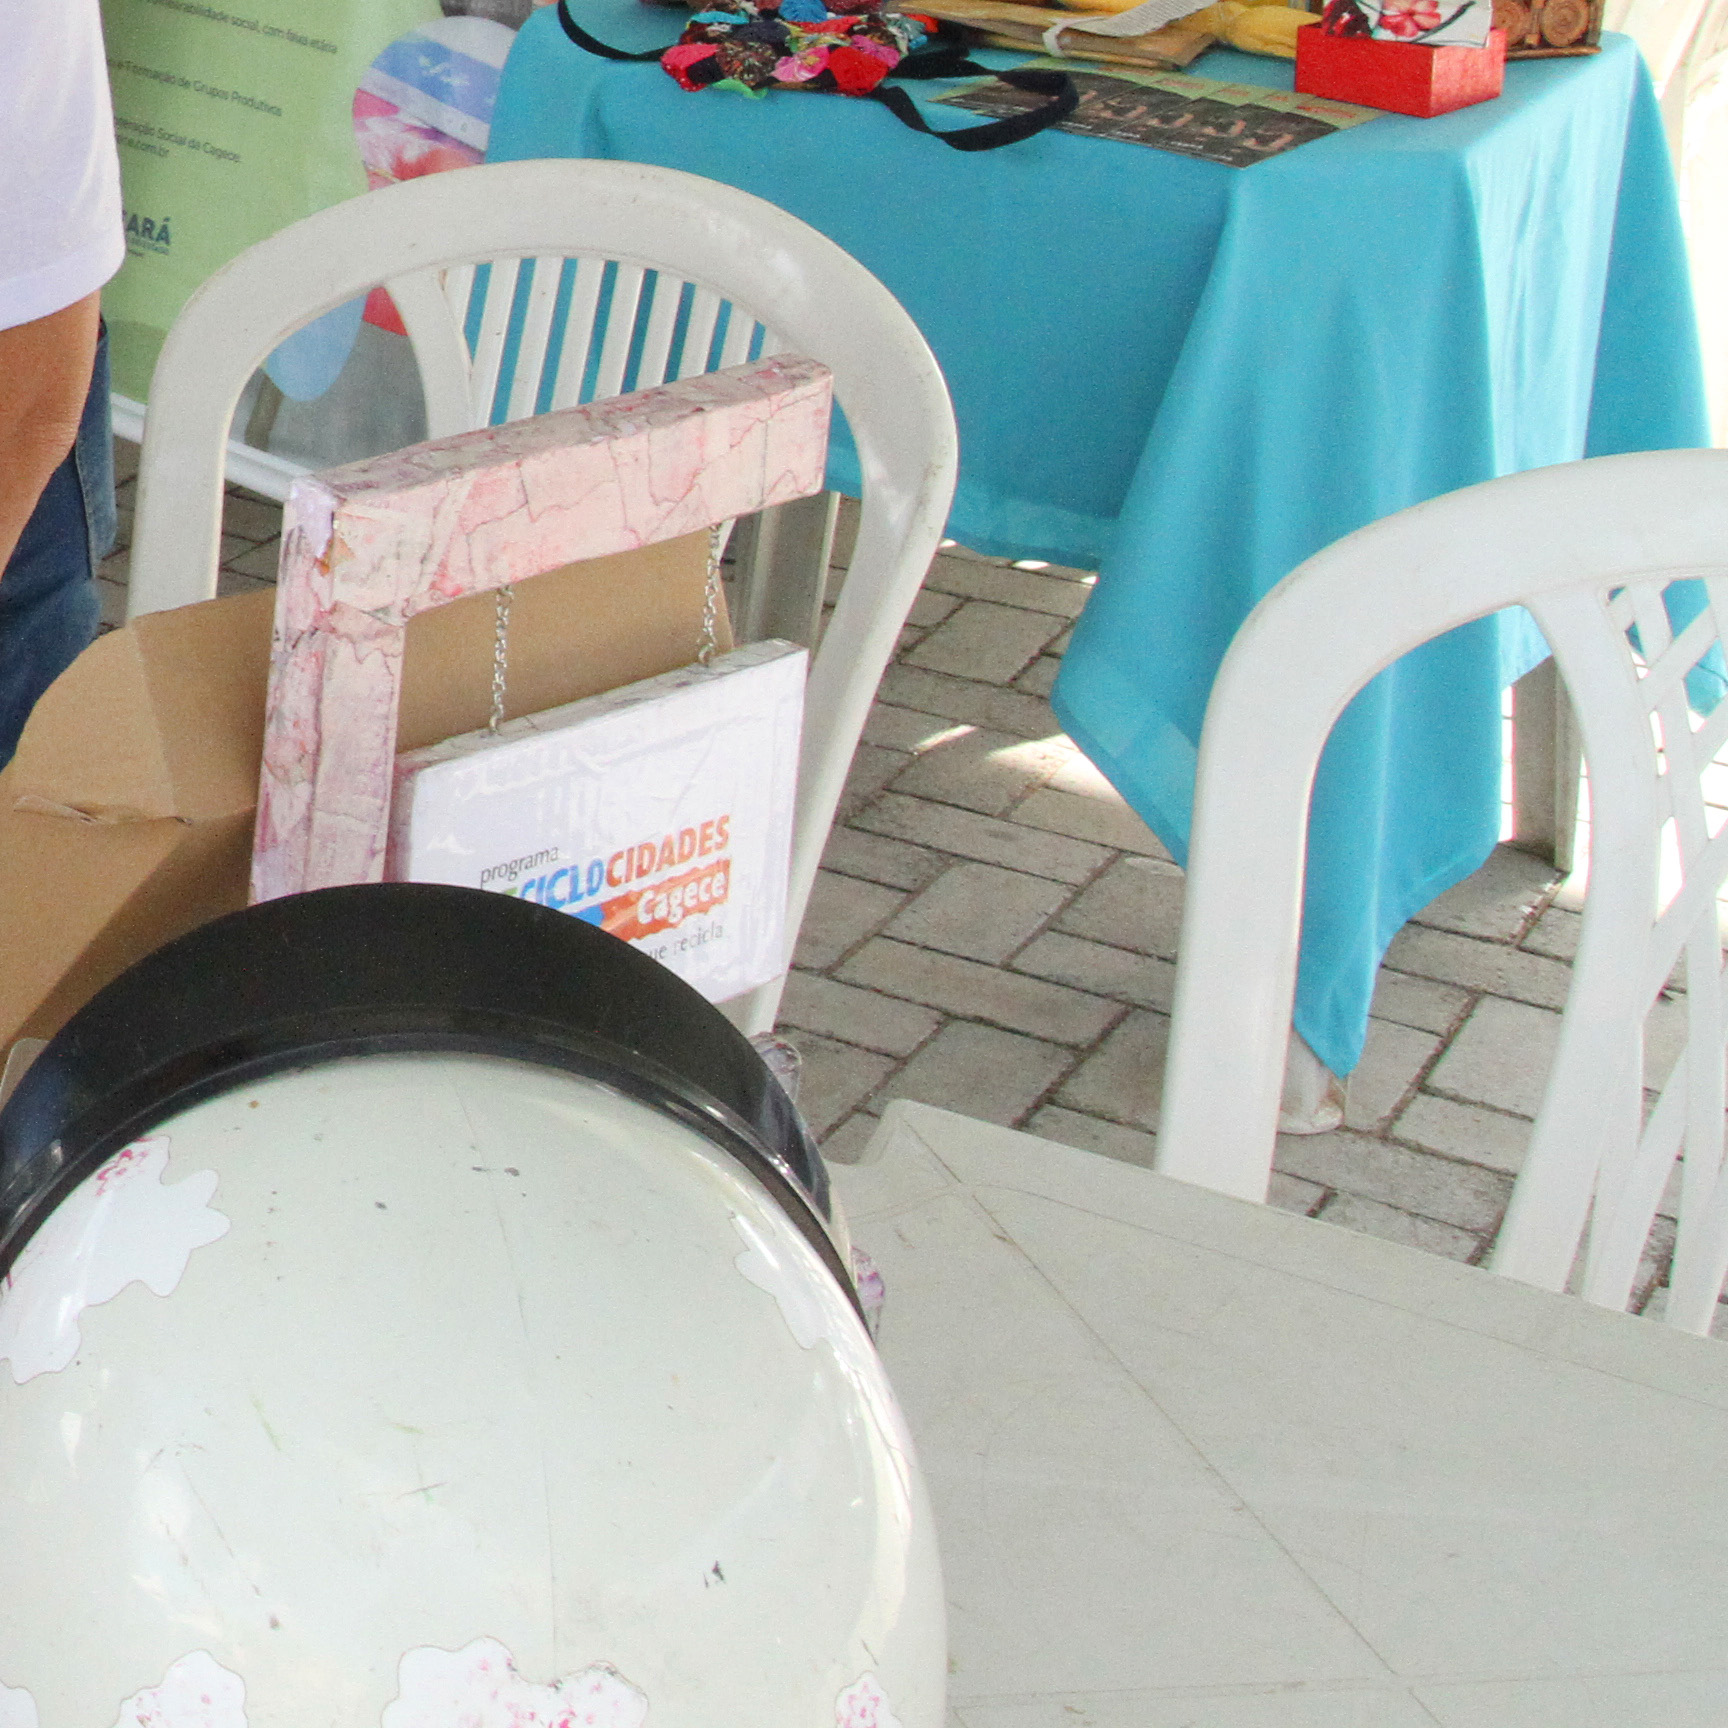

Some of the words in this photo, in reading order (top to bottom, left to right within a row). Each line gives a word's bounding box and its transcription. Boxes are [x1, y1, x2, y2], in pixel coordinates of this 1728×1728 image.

[123, 209, 172, 246] ARÁ
[480, 847, 559, 890] programa
[504, 814, 731, 910] CICLOCIDADES
[637, 870, 726, 925] Cagece
[672, 921, 724, 955] recicla
